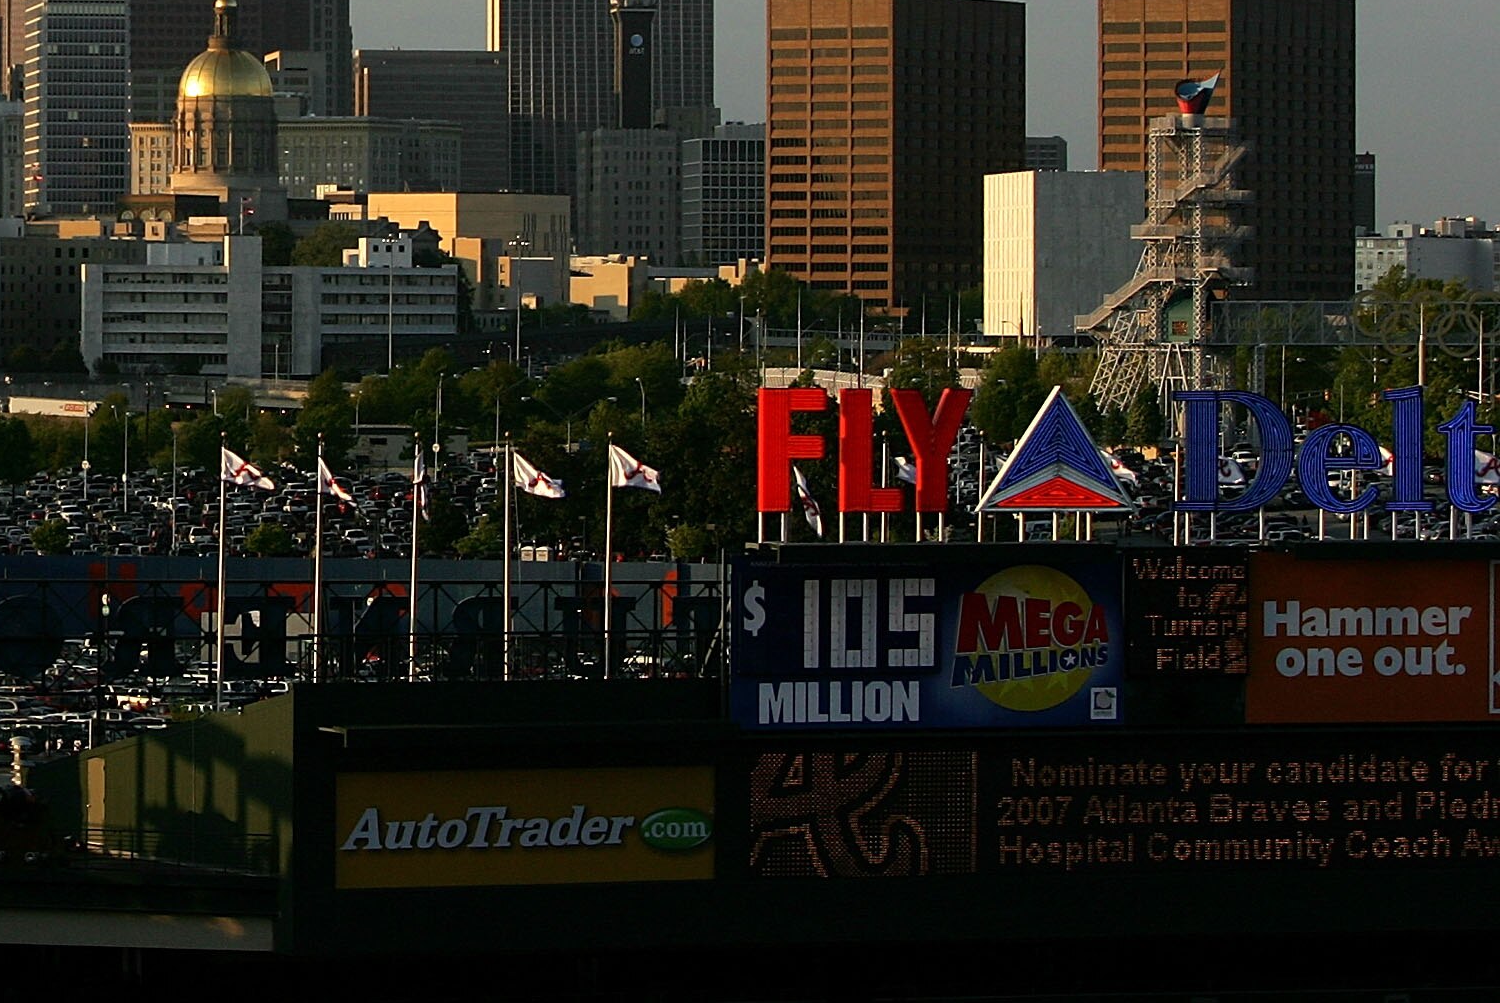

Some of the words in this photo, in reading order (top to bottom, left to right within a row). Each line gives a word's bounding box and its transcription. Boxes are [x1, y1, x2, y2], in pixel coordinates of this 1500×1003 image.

[756, 387, 975, 513] FLY
[1172, 385, 1499, 514] Delt
[1132, 555, 1245, 580] Welcome
[1177, 586, 1202, 608] to
[743, 579, 766, 637] $
[803, 578, 936, 669] 105
[955, 592, 1110, 656] MEGA
[1143, 613, 1233, 636] Turner
[1263, 600, 1472, 637] Hammer
[948, 644, 1111, 689] MILLIONS
[1156, 645, 1221, 671] Field
[1275, 647, 1363, 677] one
[1373, 639, 1466, 676] out.
[758, 680, 920, 724] MILLION
[1011, 757, 1168, 787] Nominate
[1178, 762, 1255, 792] your
[1266, 754, 1430, 784] candidate
[1440, 750, 1490, 782] for
[340, 805, 635, 851] AutoTrader
[643, 818, 711, 839] .com
[997, 796, 1073, 826] 2007
[1083, 795, 1199, 824] Atlanta
[1209, 794, 1330, 823] Braves
[1342, 790, 1403, 821] and
[999, 834, 1134, 871] Hospital
[1147, 831, 1335, 867] Community
[1345, 828, 1452, 859] Coach
